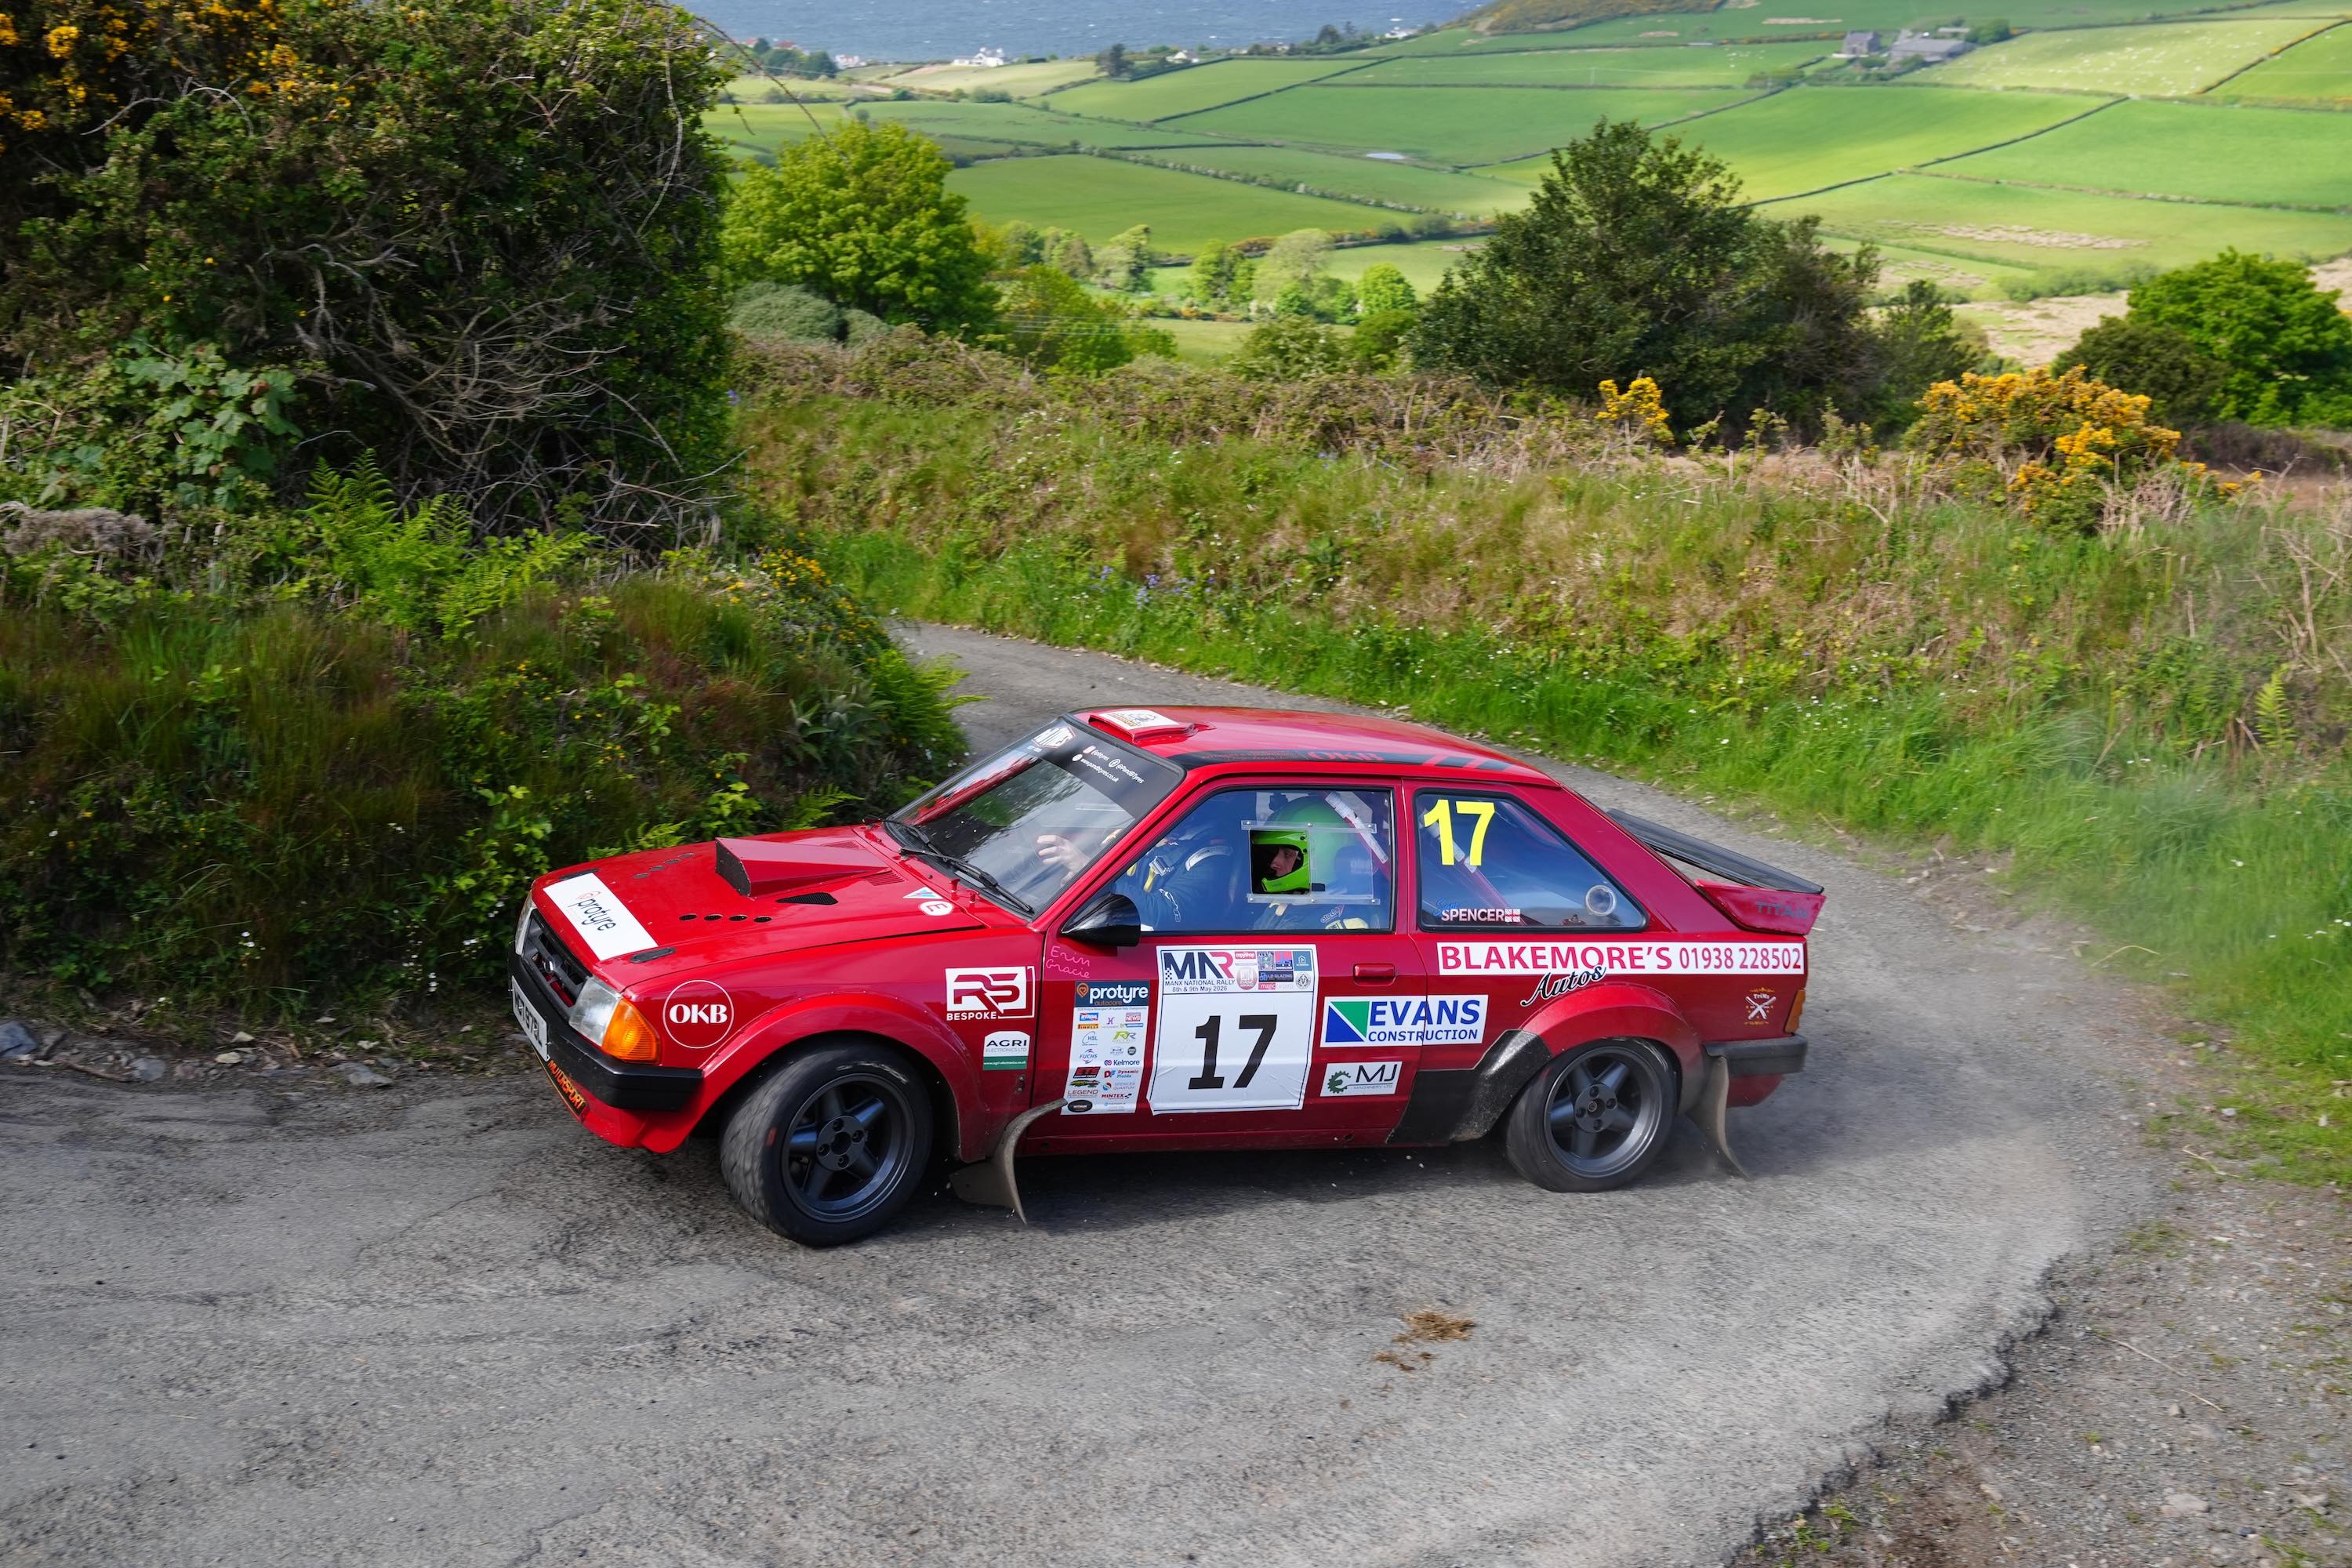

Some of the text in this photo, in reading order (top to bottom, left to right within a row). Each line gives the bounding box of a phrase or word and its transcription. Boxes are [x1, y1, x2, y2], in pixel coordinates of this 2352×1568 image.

[1424, 800, 1495, 866] 17
[568, 898, 616, 931] protyre
[1442, 909, 1505, 921] SPENCER
[1051, 946, 1090, 967] Erin
[1679, 947, 1733, 969] 01938
[1738, 948, 1801, 969] 228502
[1045, 958, 1090, 978] Gracie
[953, 973, 1020, 1014] RS
[1089, 985, 1149, 1004] protyre
[1521, 965, 1606, 1007] Autos
[670, 1004, 728, 1024] OKB
[946, 1011, 997, 1021] BESPOKE
[1370, 1000, 1480, 1026] EVANS
[1368, 1029, 1478, 1042] CONSTRUCTION
[1188, 1014, 1278, 1090] 17
[1356, 1064, 1398, 1083] MJ
[547, 1060, 587, 1109] MOTORSPORT
